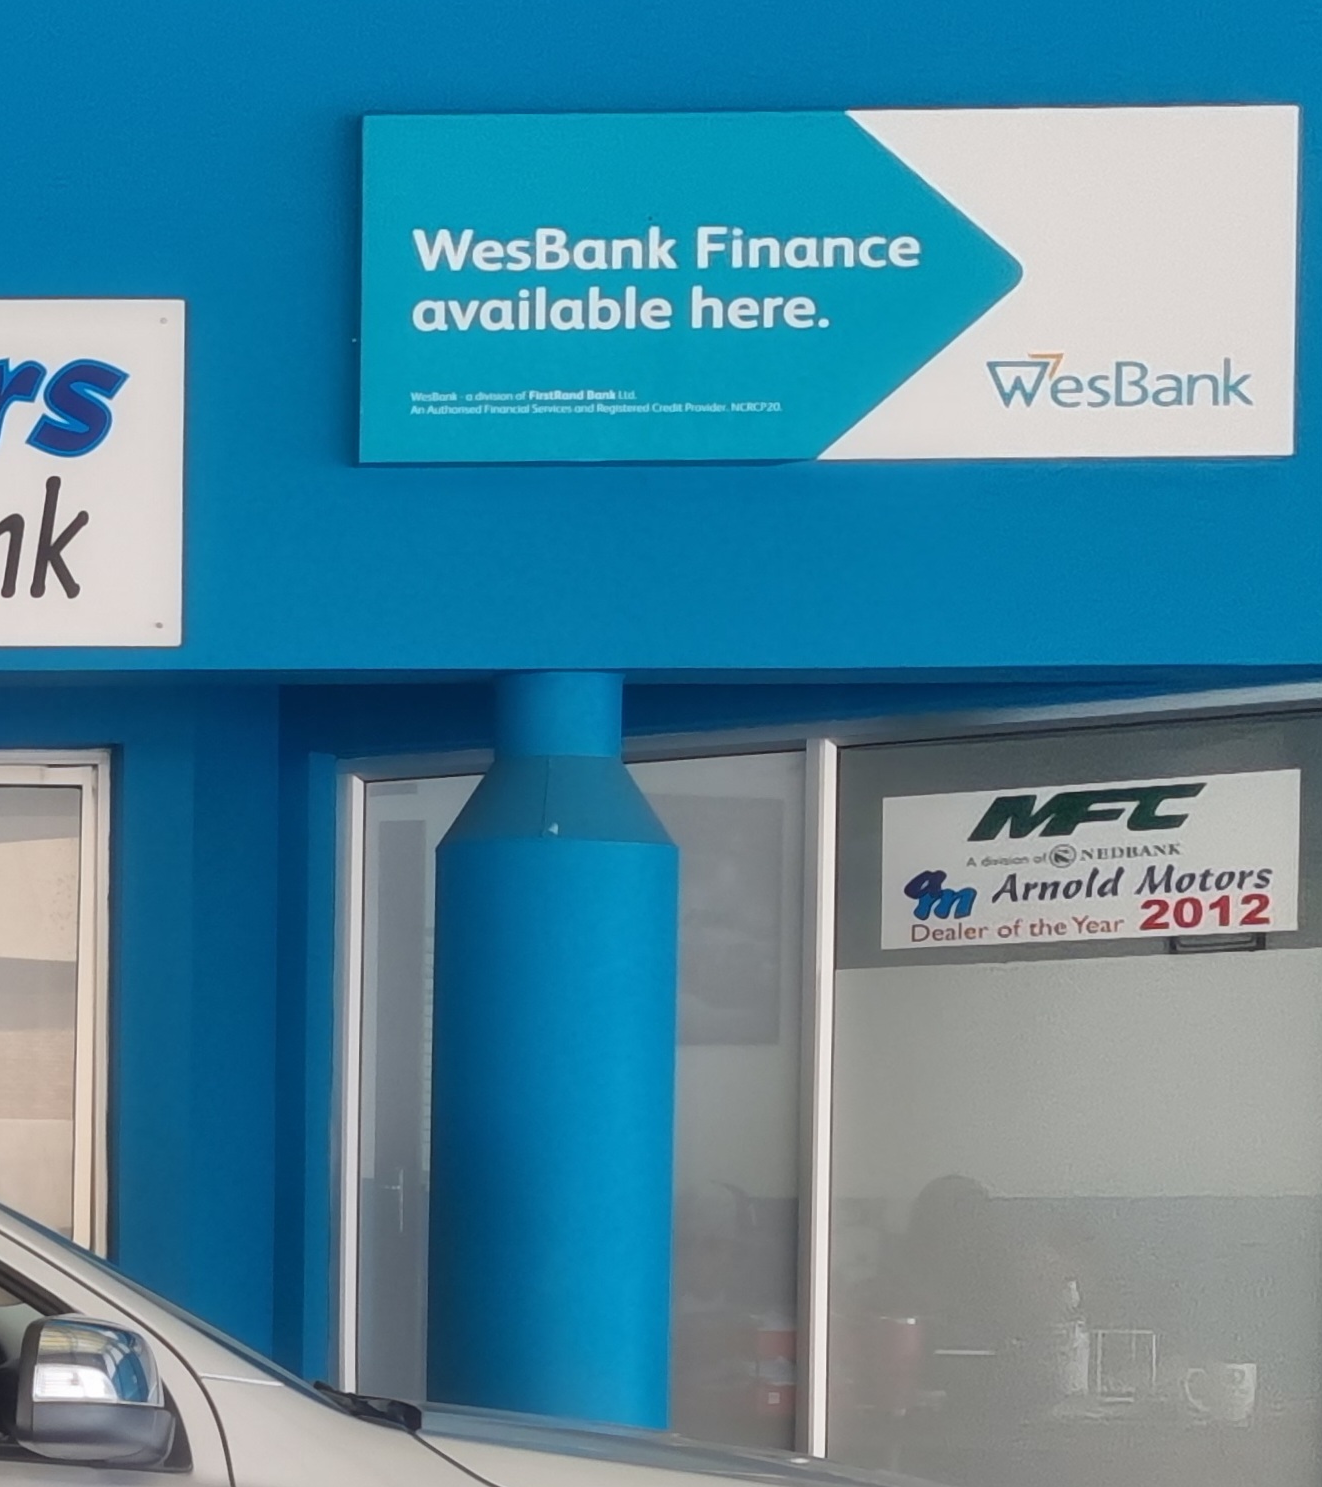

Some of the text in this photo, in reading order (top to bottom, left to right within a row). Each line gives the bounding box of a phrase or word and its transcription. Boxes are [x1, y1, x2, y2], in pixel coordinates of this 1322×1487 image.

[412, 225, 921, 271] WesBank Finance
[412, 285, 830, 331] available here.
[410, 391, 457, 401] WesBank
[474, 391, 514, 401] division
[515, 391, 527, 401] of
[528, 390, 584, 400] FirstRand
[587, 390, 616, 400] Bank
[986, 355, 1254, 408] WesBank
[410, 404, 426, 414] An
[427, 404, 483, 414] Authorised
[484, 403, 530, 414] Financial
[531, 403, 572, 413] Services
[573, 403, 595, 413] and
[597, 403, 650, 415] Registered
[652, 402, 683, 412] Credit
[967, 783, 1207, 842] MFC
[1080, 843, 1181, 862] NEDBANK
[992, 864, 1273, 904] Arnold Motors
[911, 893, 1272, 944] Dealer of the Year 2012
